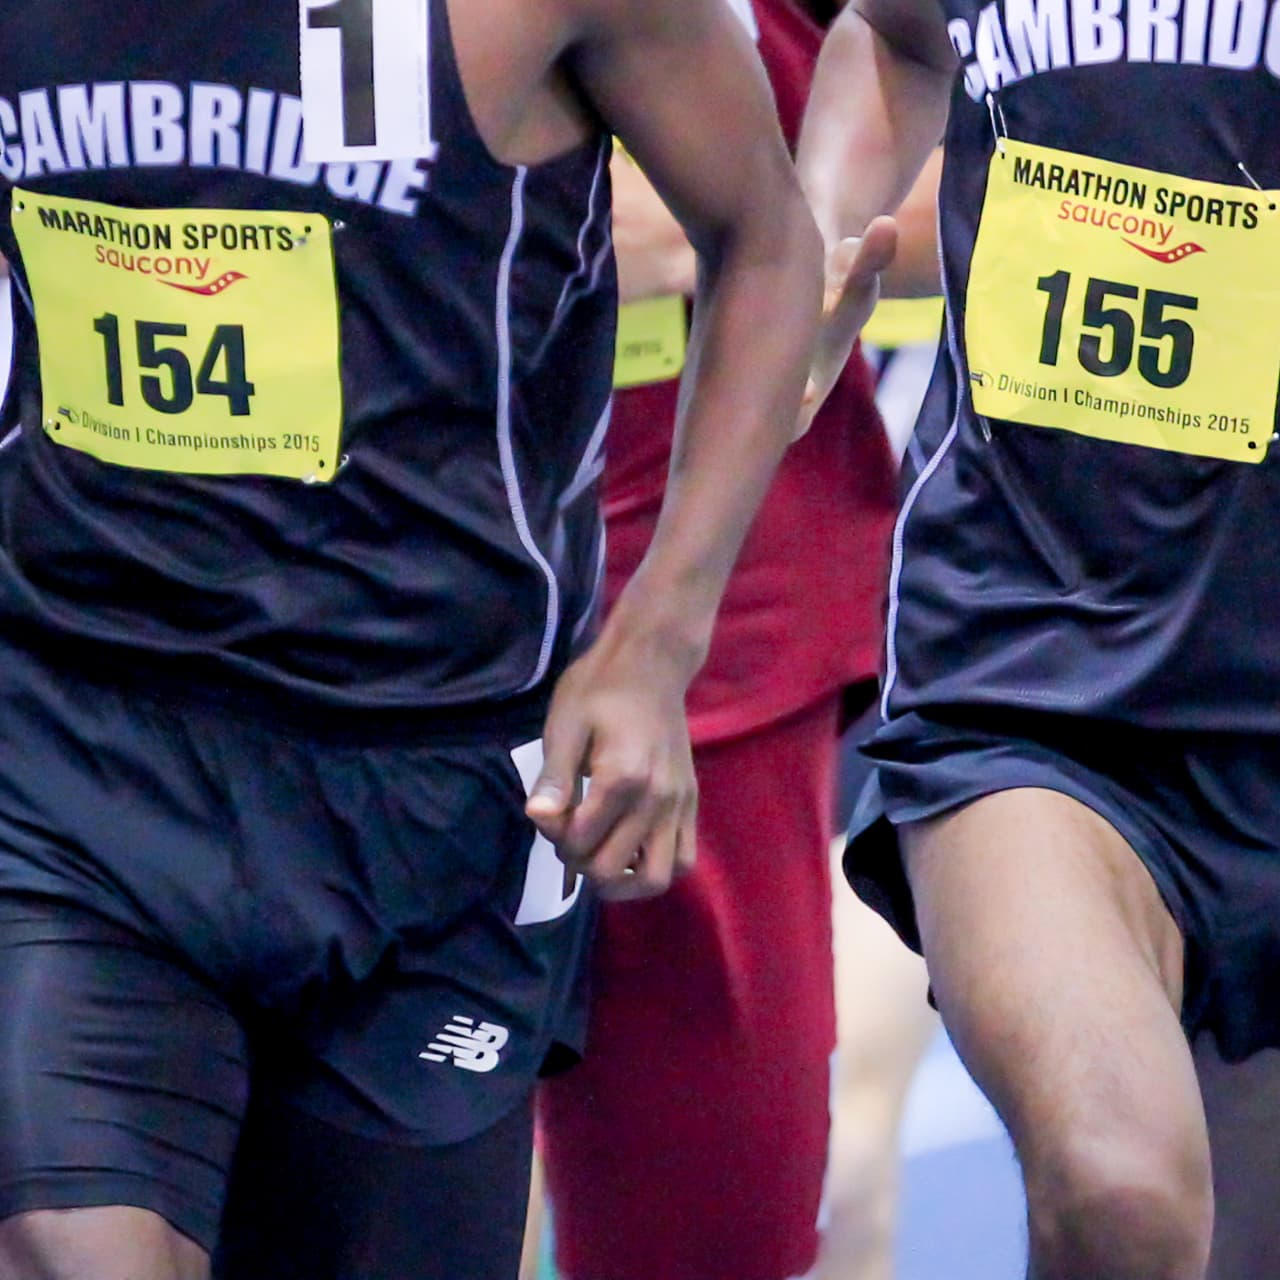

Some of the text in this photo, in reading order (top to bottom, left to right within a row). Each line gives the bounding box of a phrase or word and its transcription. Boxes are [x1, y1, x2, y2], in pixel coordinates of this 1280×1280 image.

[1013, 156, 1259, 229] MARATHON SPORTS
[37, 206, 294, 251] MARATHON SPORTS
[1057, 200, 1174, 245] saucony
[95, 244, 212, 279] saucony
[1035, 270, 1200, 389] 155
[93, 312, 255, 416] 154
[997, 374, 1057, 402] Division
[1074, 390, 1201, 428] Championships
[1207, 414, 1250, 435] 2015
[82, 411, 130, 441] Division
[146, 428, 277, 451] Championships
[283, 433, 320, 453] 2015
